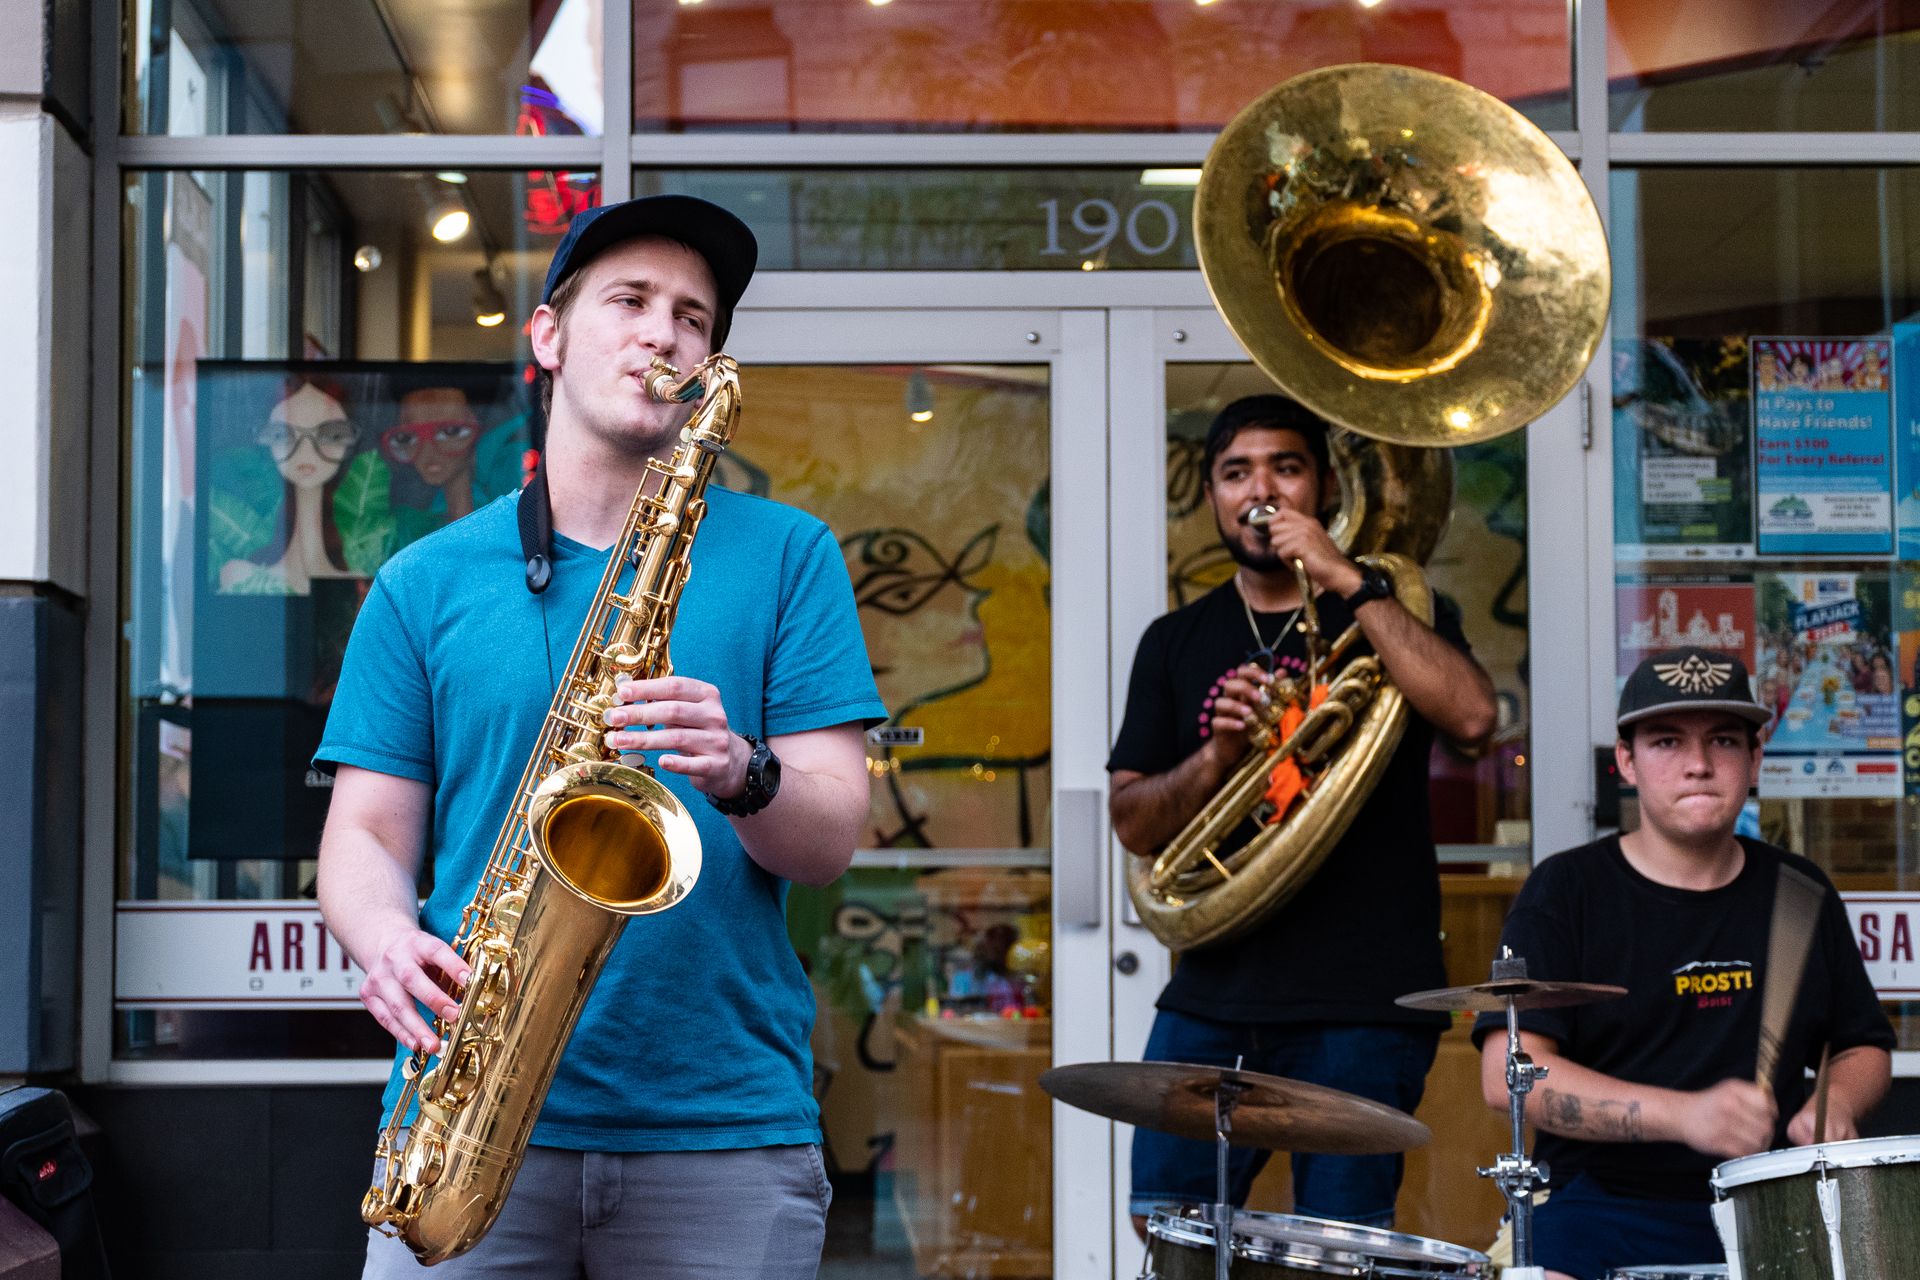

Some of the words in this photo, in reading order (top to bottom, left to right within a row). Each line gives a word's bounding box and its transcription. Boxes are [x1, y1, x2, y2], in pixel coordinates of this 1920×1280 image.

[1037, 198, 1179, 255] 190
[1775, 397, 1813, 413] Pays
[1816, 398, 1834, 411] to
[1759, 416, 1800, 429] Have
[1804, 415, 1872, 430] Friends!
[1759, 438, 1790, 449] Earn
[1758, 454, 1780, 465] For
[1786, 453, 1824, 467] Every
[1828, 453, 1884, 465] Referral
[1795, 601, 1860, 630] FLAPJACK
[1675, 970, 1753, 996] PROST!
